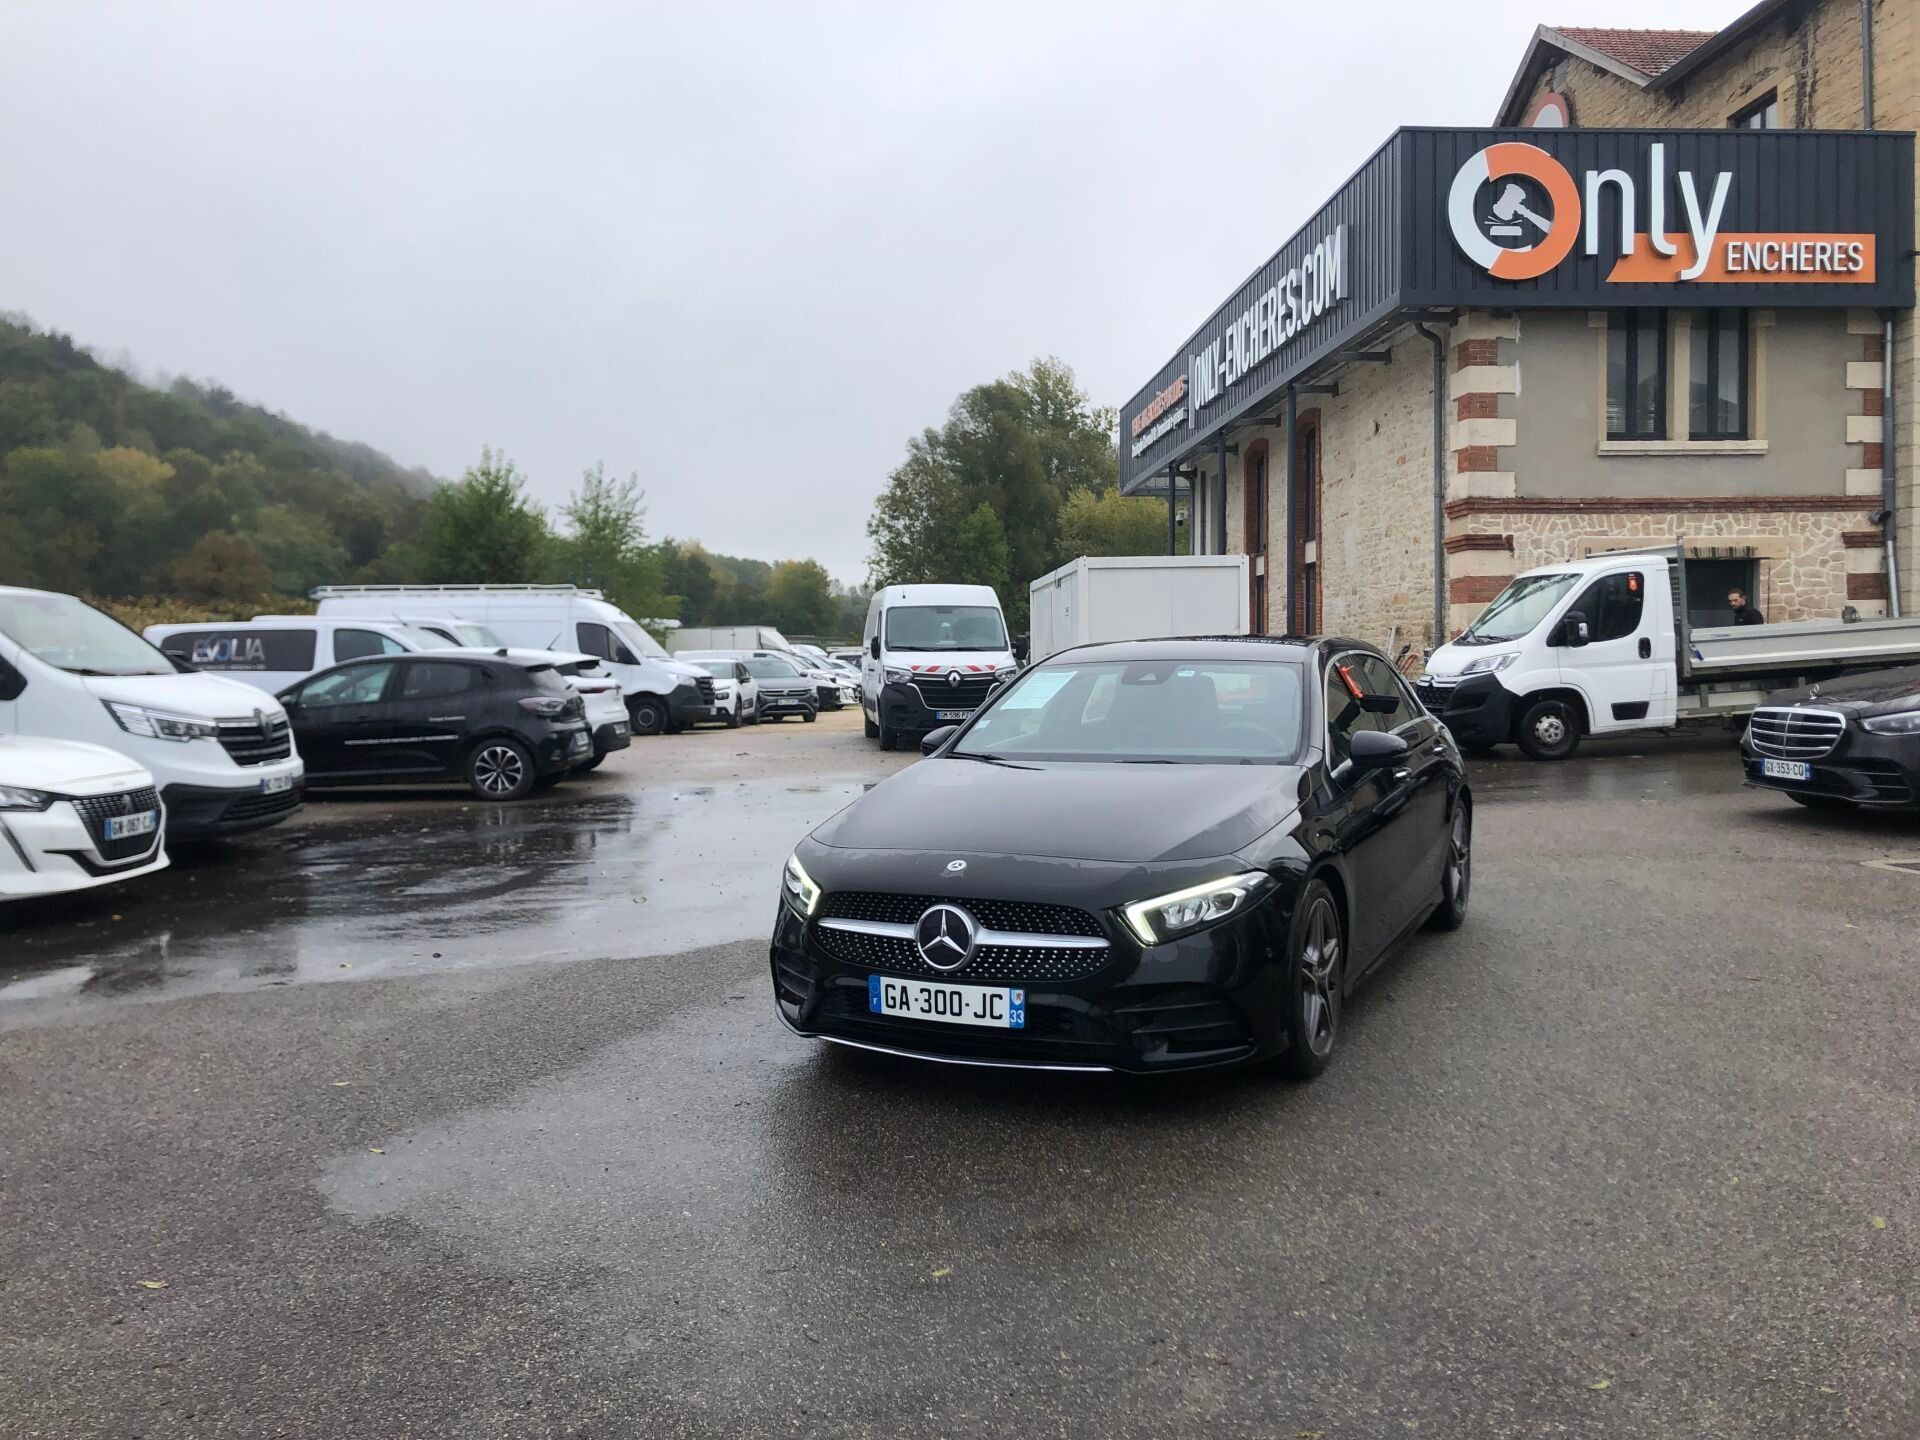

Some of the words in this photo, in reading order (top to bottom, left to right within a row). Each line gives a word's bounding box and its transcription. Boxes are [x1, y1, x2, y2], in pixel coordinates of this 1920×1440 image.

[1448, 142, 1733, 281] Only
[1726, 241, 1864, 272] ENCHERES
[1194, 224, 1343, 411] ONLY-ENCHERES.COM
[885, 984, 1003, 1020] GA-300-JC
[1009, 1009, 1024, 1024] 33
